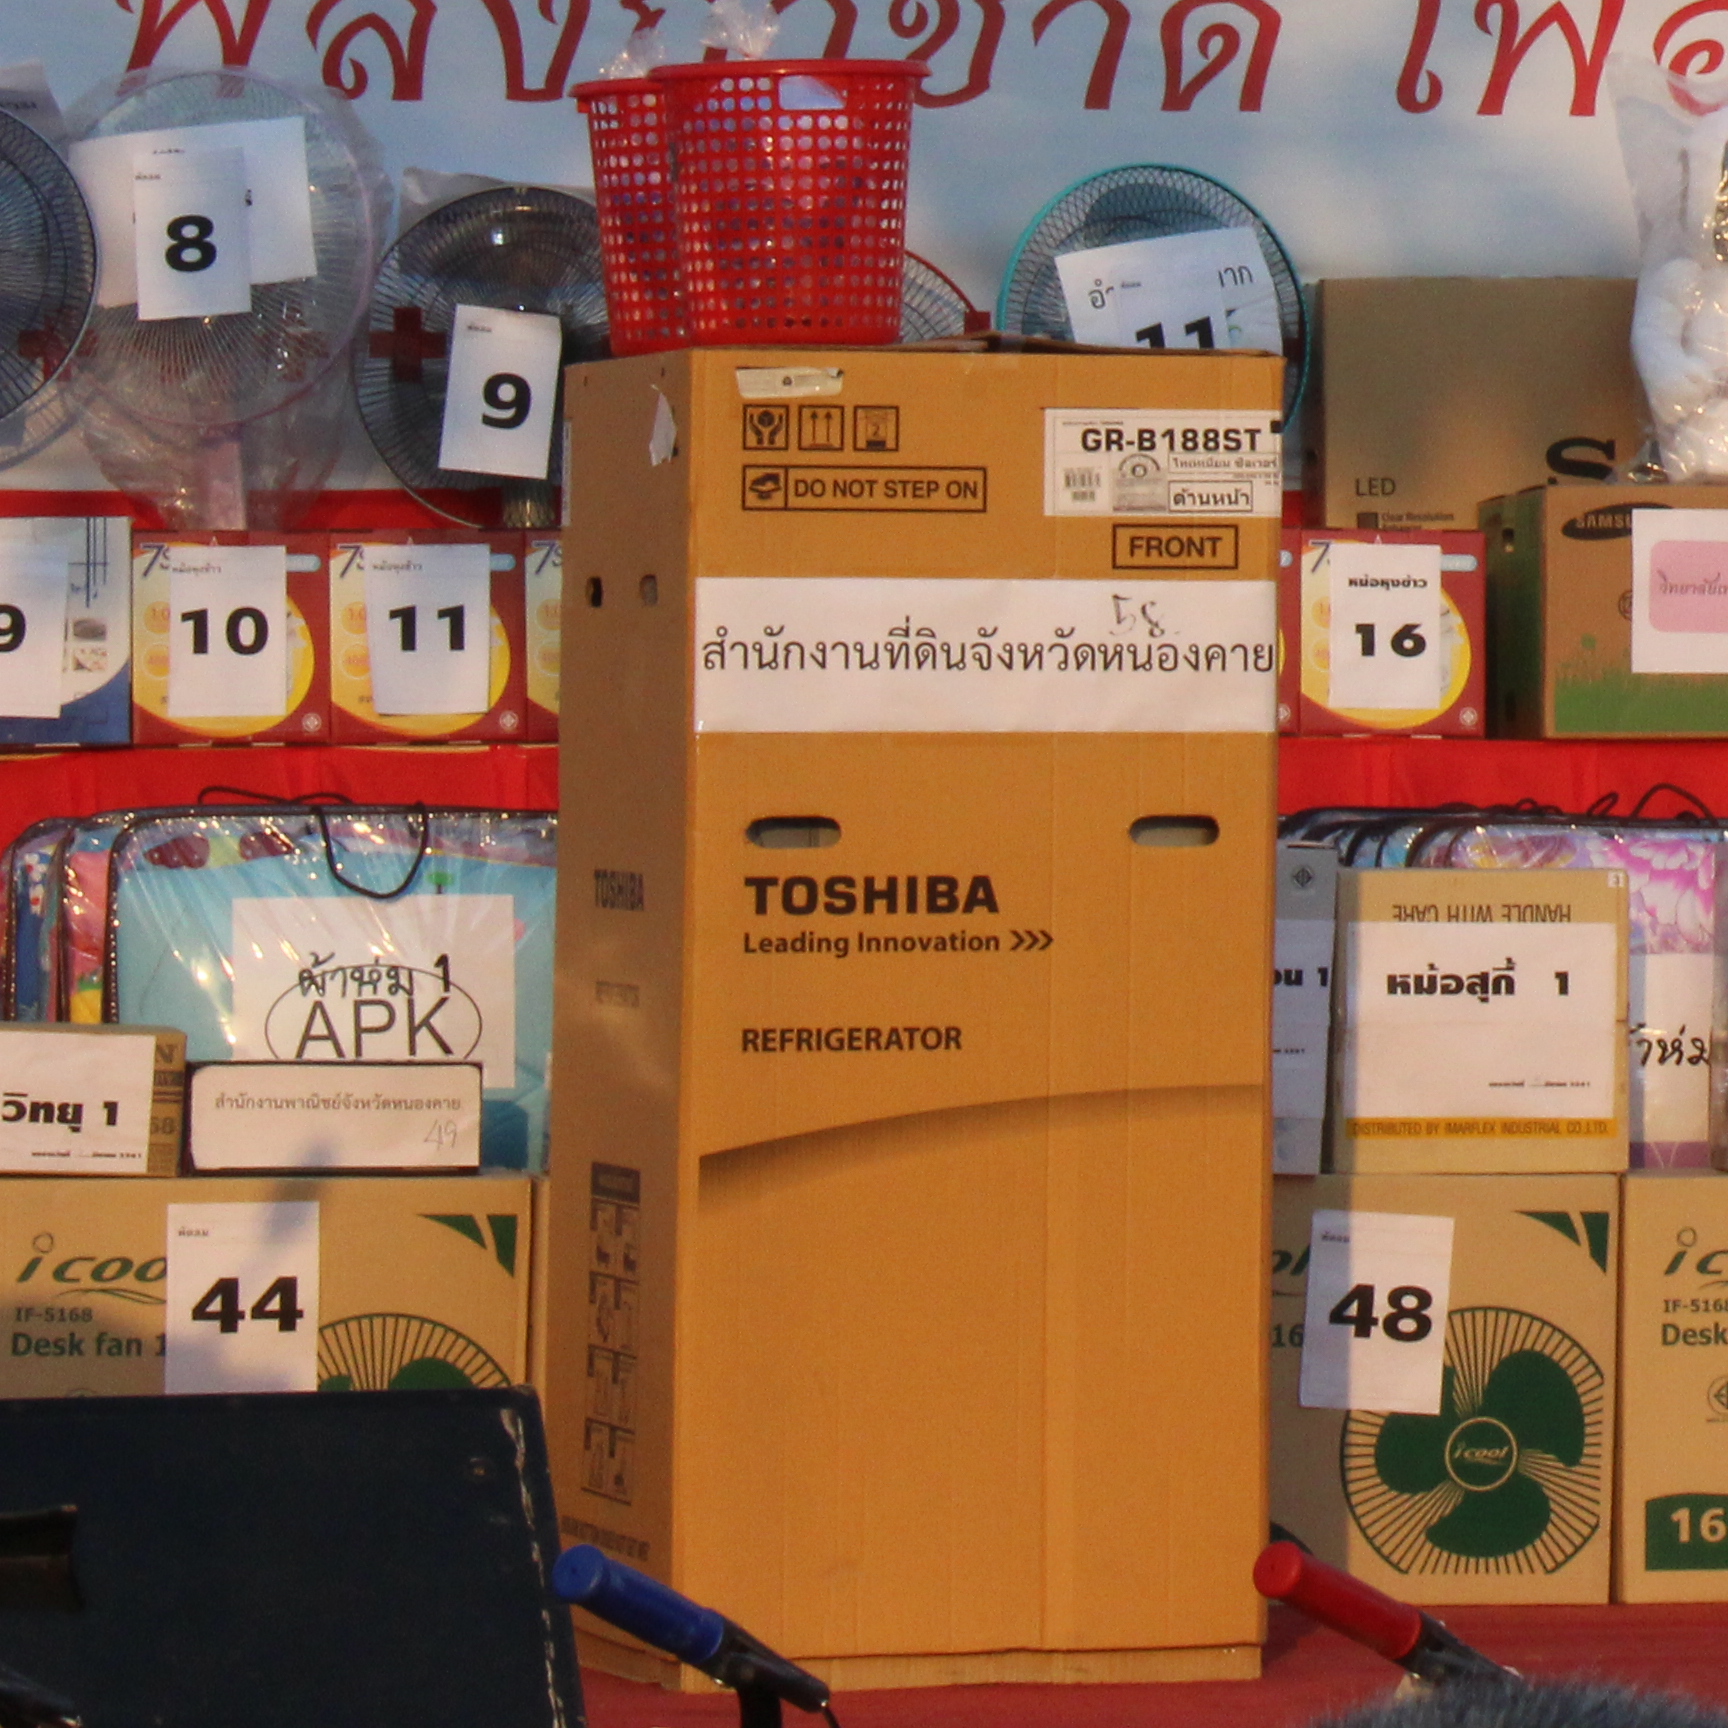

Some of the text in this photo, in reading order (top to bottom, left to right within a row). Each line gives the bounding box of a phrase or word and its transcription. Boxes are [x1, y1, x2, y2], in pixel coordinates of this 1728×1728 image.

[165, 214, 217, 272] 8
[480, 372, 532, 430] 9
[1081, 428, 1262, 452] GR-B188ST
[793, 478, 978, 500] DO NOT STEP ON
[1355, 477, 1397, 497] LED
[1130, 537, 1224, 558] FRONT
[180, 606, 269, 655] 10
[388, 605, 466, 652] 11
[1354, 623, 1427, 658] 16
[702, 615, 1275, 672] สำนักงานที่ดินจังหวัดหนองคาย
[594, 869, 645, 912] TOSHIBA
[744, 875, 999, 915] TOSHIBA
[743, 930, 1000, 958] Leading Innovation
[1554, 970, 1570, 996] 1
[296, 996, 455, 1060] APK
[742, 1027, 962, 1053] REFRIGERATOR
[103, 1100, 118, 1127] 1
[14, 1306, 94, 1322] IF-5168
[191, 1275, 305, 1335] 44
[1329, 1283, 1434, 1343] 48
[11, 1331, 88, 1358] Desk
[96, 1330, 143, 1358] fan
[1661, 1322, 1728, 1347] Desk
[1455, 1440, 1509, 1463] icool
